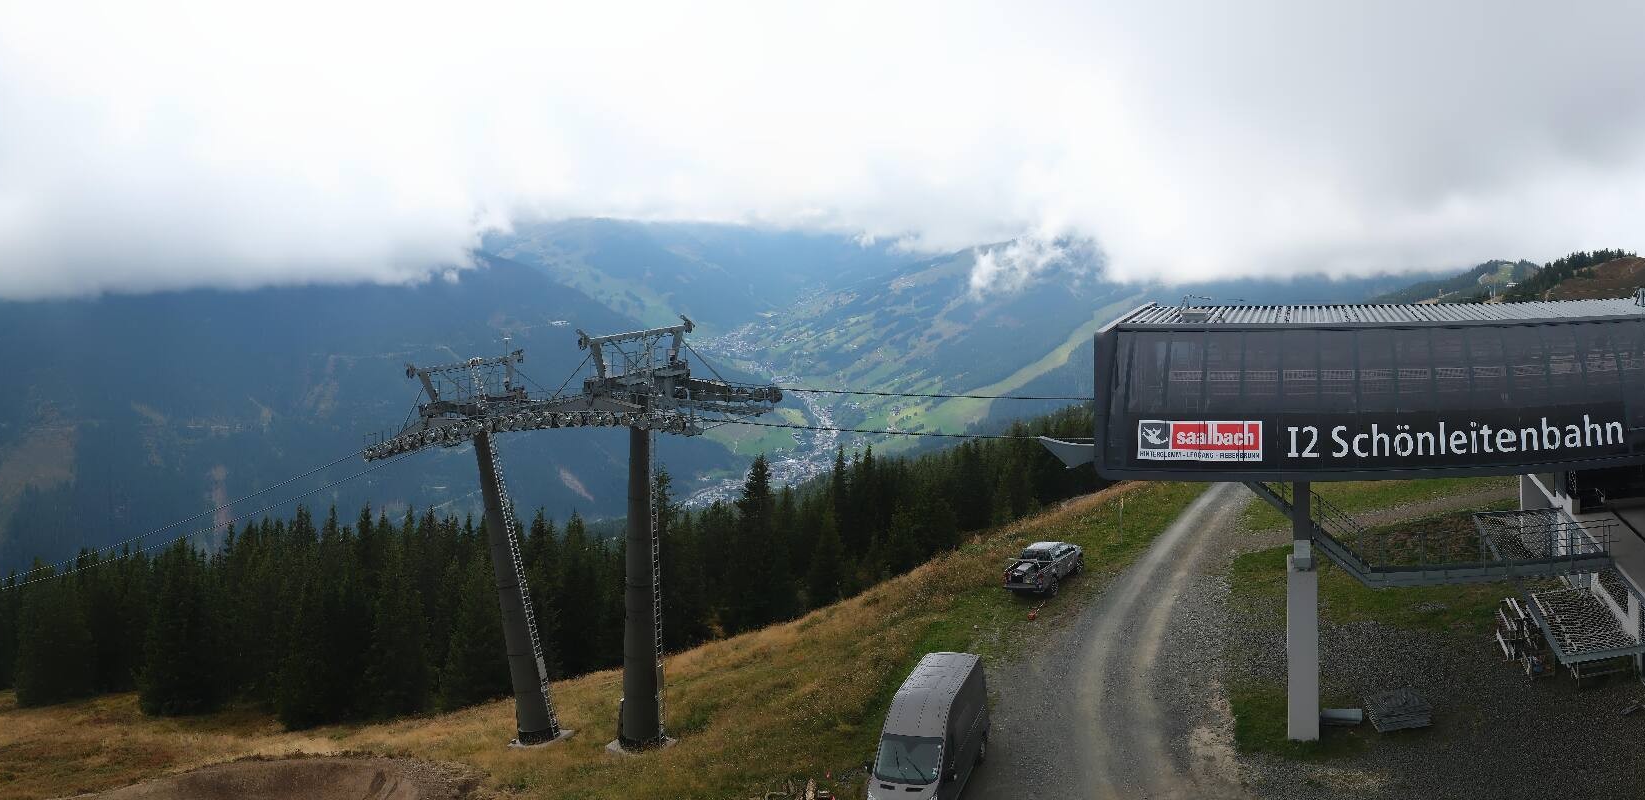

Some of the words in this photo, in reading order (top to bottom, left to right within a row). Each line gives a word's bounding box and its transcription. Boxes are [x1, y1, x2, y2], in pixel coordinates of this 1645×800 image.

[1176, 422, 1255, 446] saalbach
[1287, 426, 1320, 458] I2
[1331, 414, 1624, 458] Schönleitenbahn
